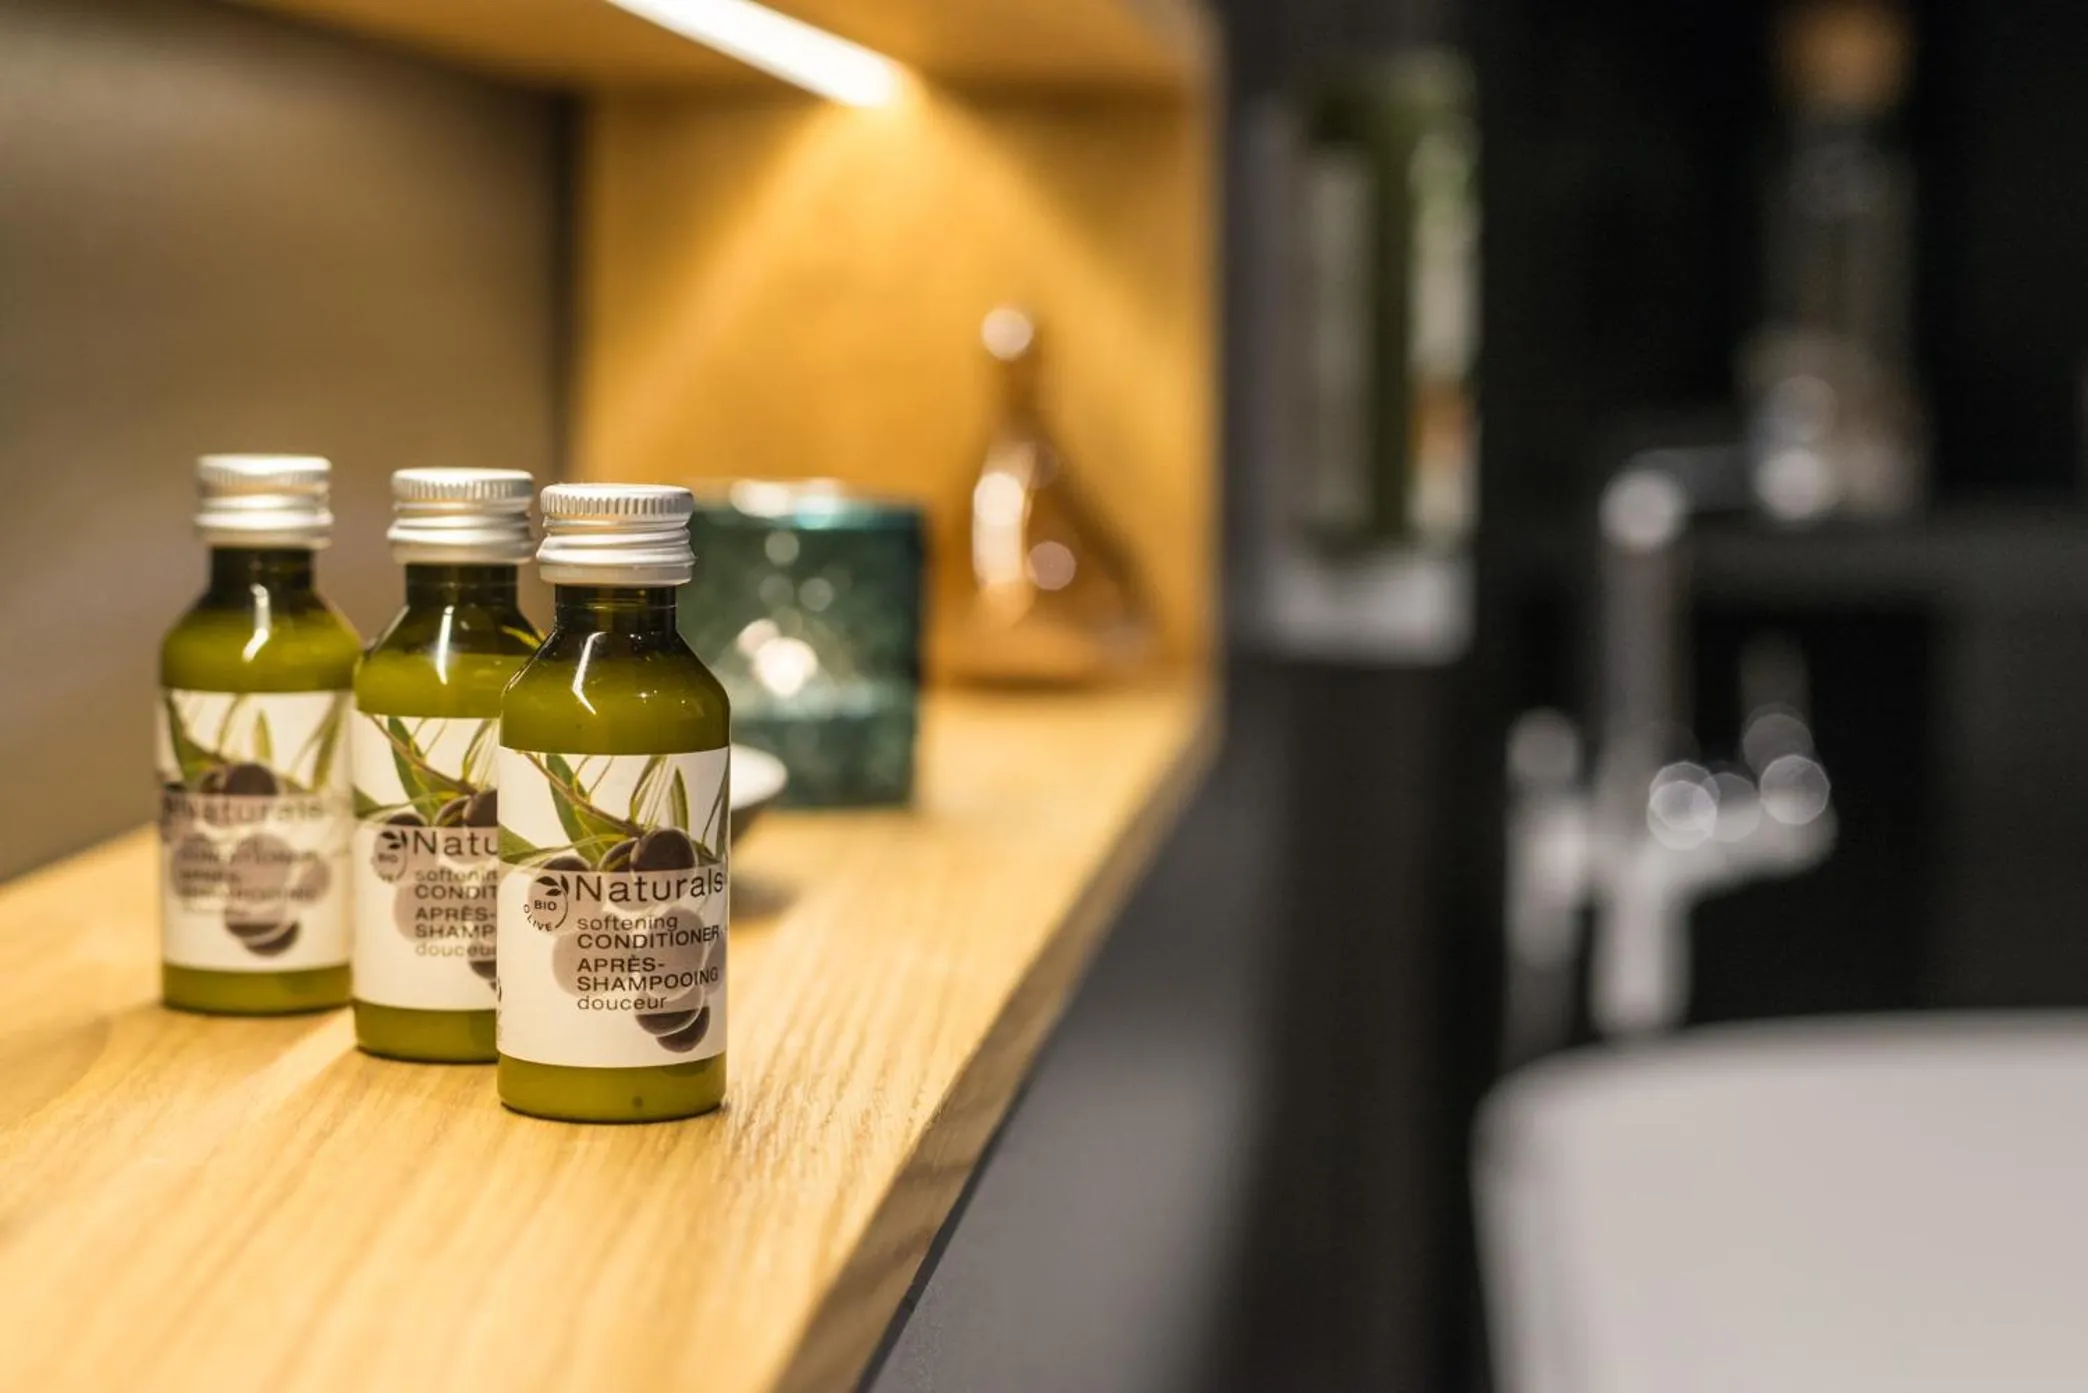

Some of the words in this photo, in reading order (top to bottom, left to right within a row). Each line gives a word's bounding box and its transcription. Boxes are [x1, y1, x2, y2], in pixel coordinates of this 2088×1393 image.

[575, 867, 724, 902] Naturals
[534, 899, 558, 912] BIO
[576, 915, 678, 933] softening
[576, 923, 720, 951] CONDITIONER
[576, 953, 667, 974] APRÈS-
[576, 966, 720, 993] SHAMPOOING
[576, 994, 668, 1011] douceur
